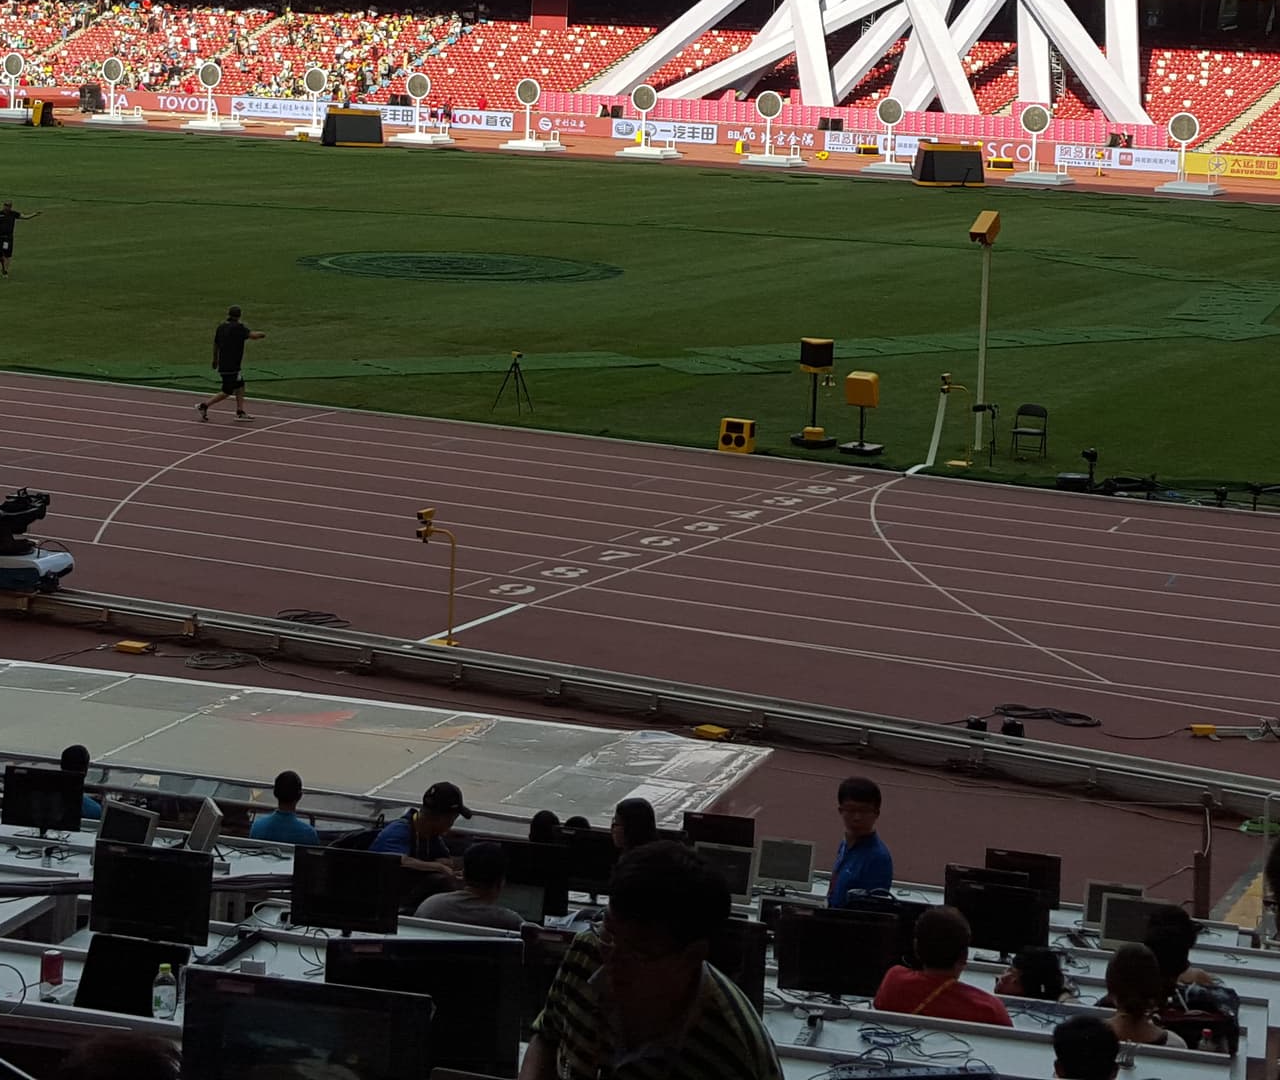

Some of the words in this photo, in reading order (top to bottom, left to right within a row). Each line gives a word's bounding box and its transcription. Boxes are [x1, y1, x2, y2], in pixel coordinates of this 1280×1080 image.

[157, 96, 218, 112] TOYOTA
[660, 125, 714, 140] 一汽丰田
[1231, 158, 1278, 170] 大运集团
[683, 521, 726, 532] 5
[640, 535, 681, 546] 6
[598, 550, 641, 561] 7
[540, 566, 589, 579] 8
